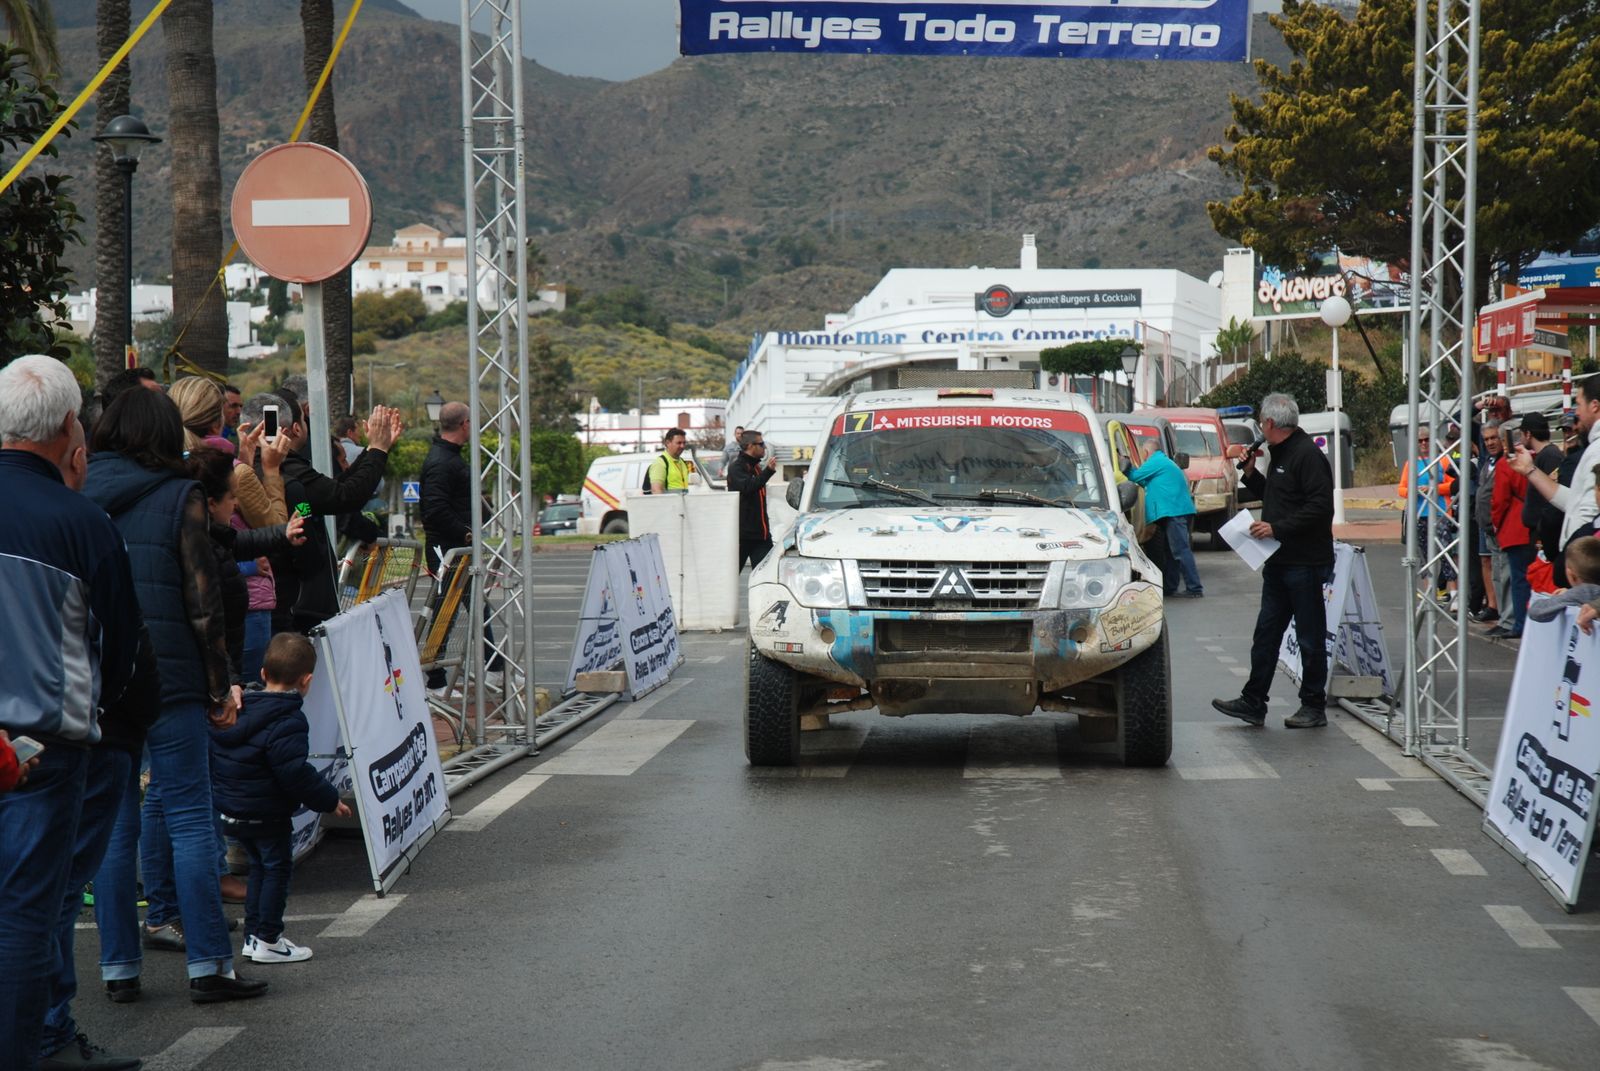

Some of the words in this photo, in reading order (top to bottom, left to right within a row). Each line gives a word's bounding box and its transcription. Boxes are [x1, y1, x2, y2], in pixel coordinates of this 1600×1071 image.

[708, 11, 882, 48] Rallyes
[898, 13, 1016, 42] Todo
[1032, 14, 1221, 47] Terreno
[1024, 295, 1059, 305] Gourmet
[1060, 294, 1091, 306] Burgers
[1093, 295, 1100, 303] &
[1101, 292, 1137, 303] Cocktails
[921, 328, 1004, 344] Centro
[852, 412, 869, 432] 7
[896, 415, 982, 428] MITSUBISHI
[990, 415, 1053, 428] MOTORS
[857, 525, 933, 534] BULL
